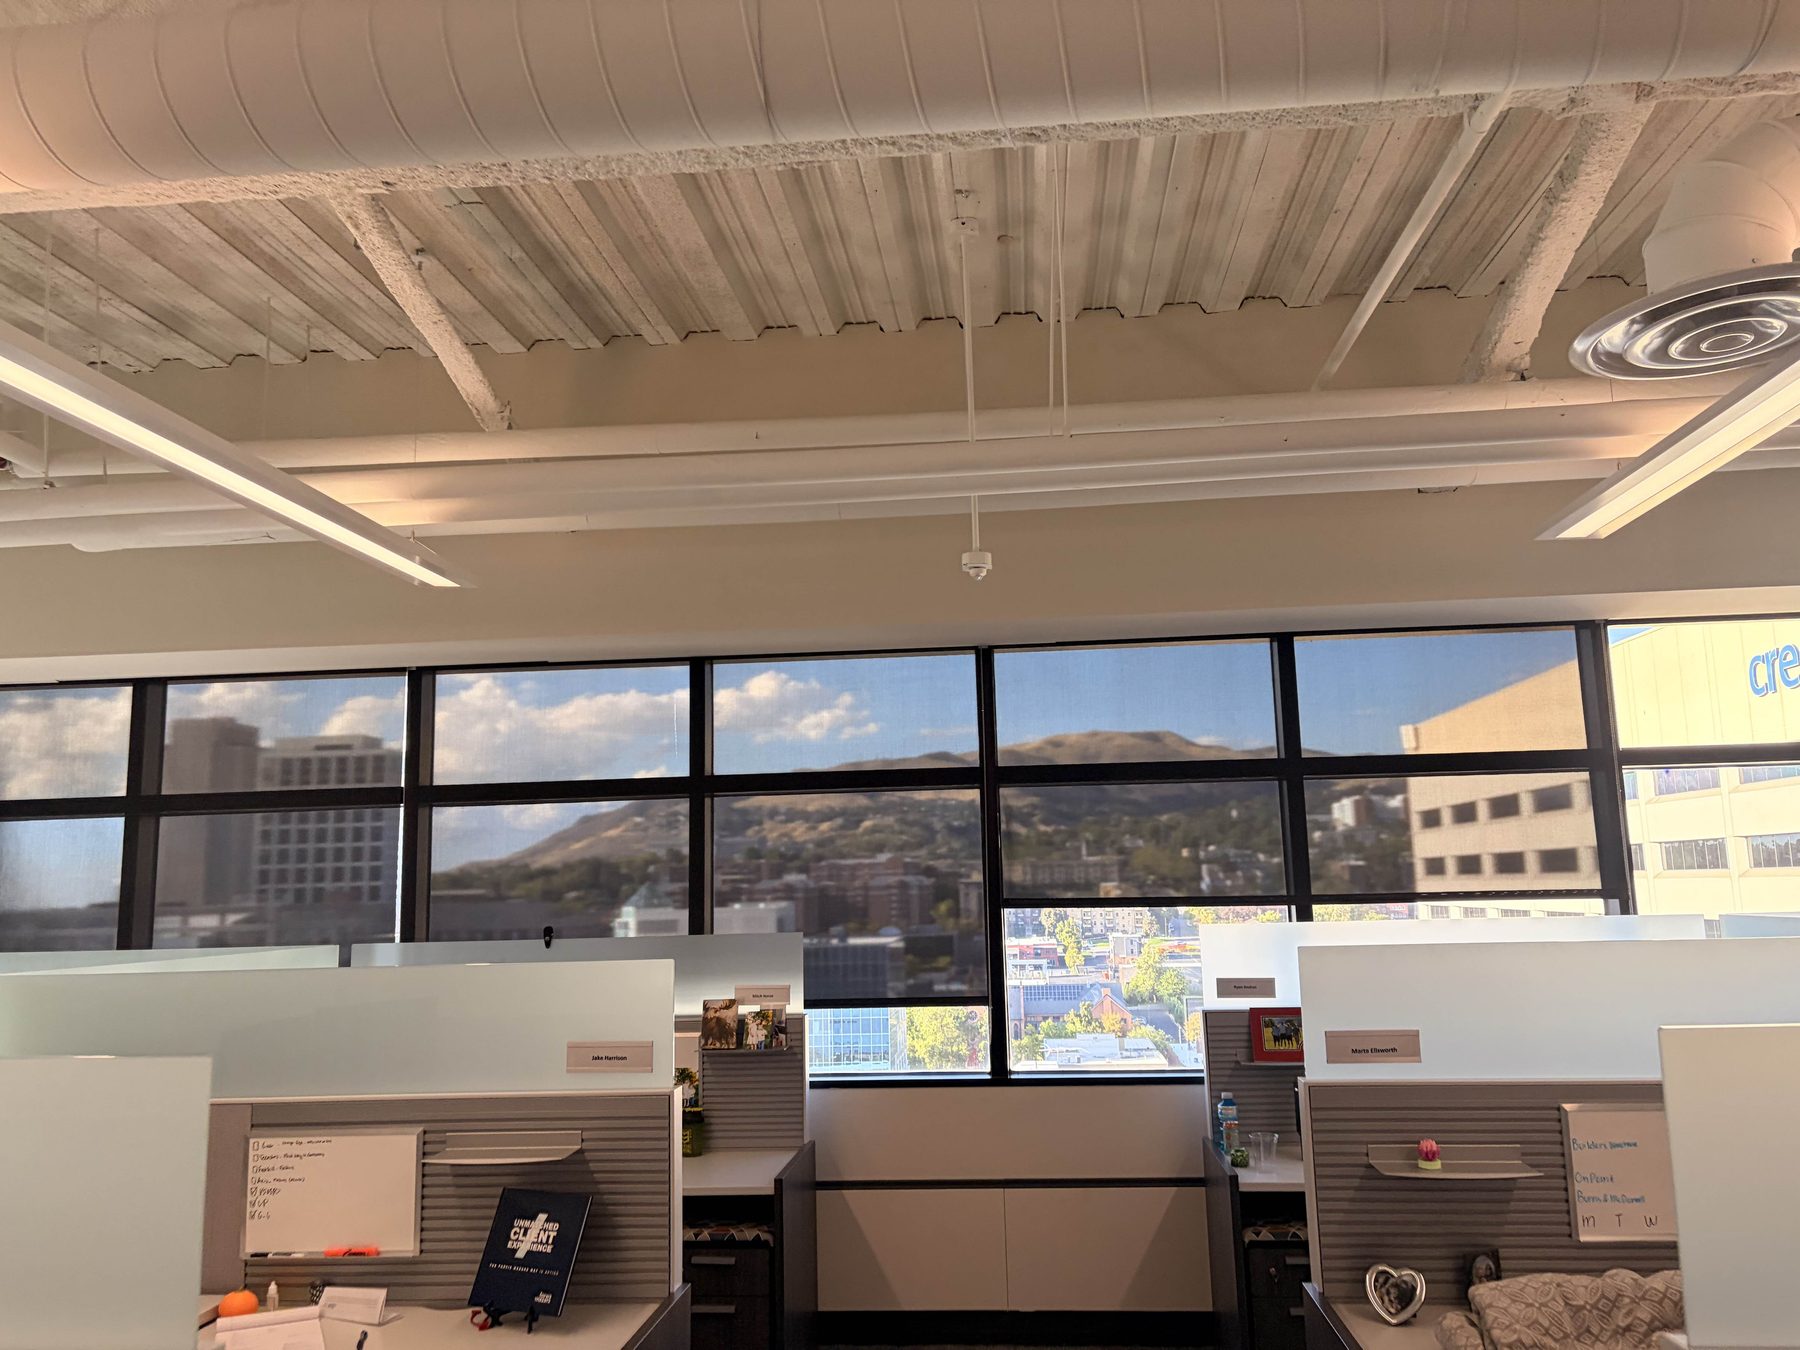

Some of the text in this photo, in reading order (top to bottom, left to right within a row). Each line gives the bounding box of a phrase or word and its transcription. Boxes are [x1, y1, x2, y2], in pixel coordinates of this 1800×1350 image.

[1370, 1046, 1398, 1054] Ellsworth
[513, 1218, 560, 1231] UNMAHED
[1615, 1213, 1623, 1228] T
[1644, 1215, 1658, 1228] W
[510, 1227, 557, 1244] CLENT
[506, 1240, 554, 1253] EXPIENCE
